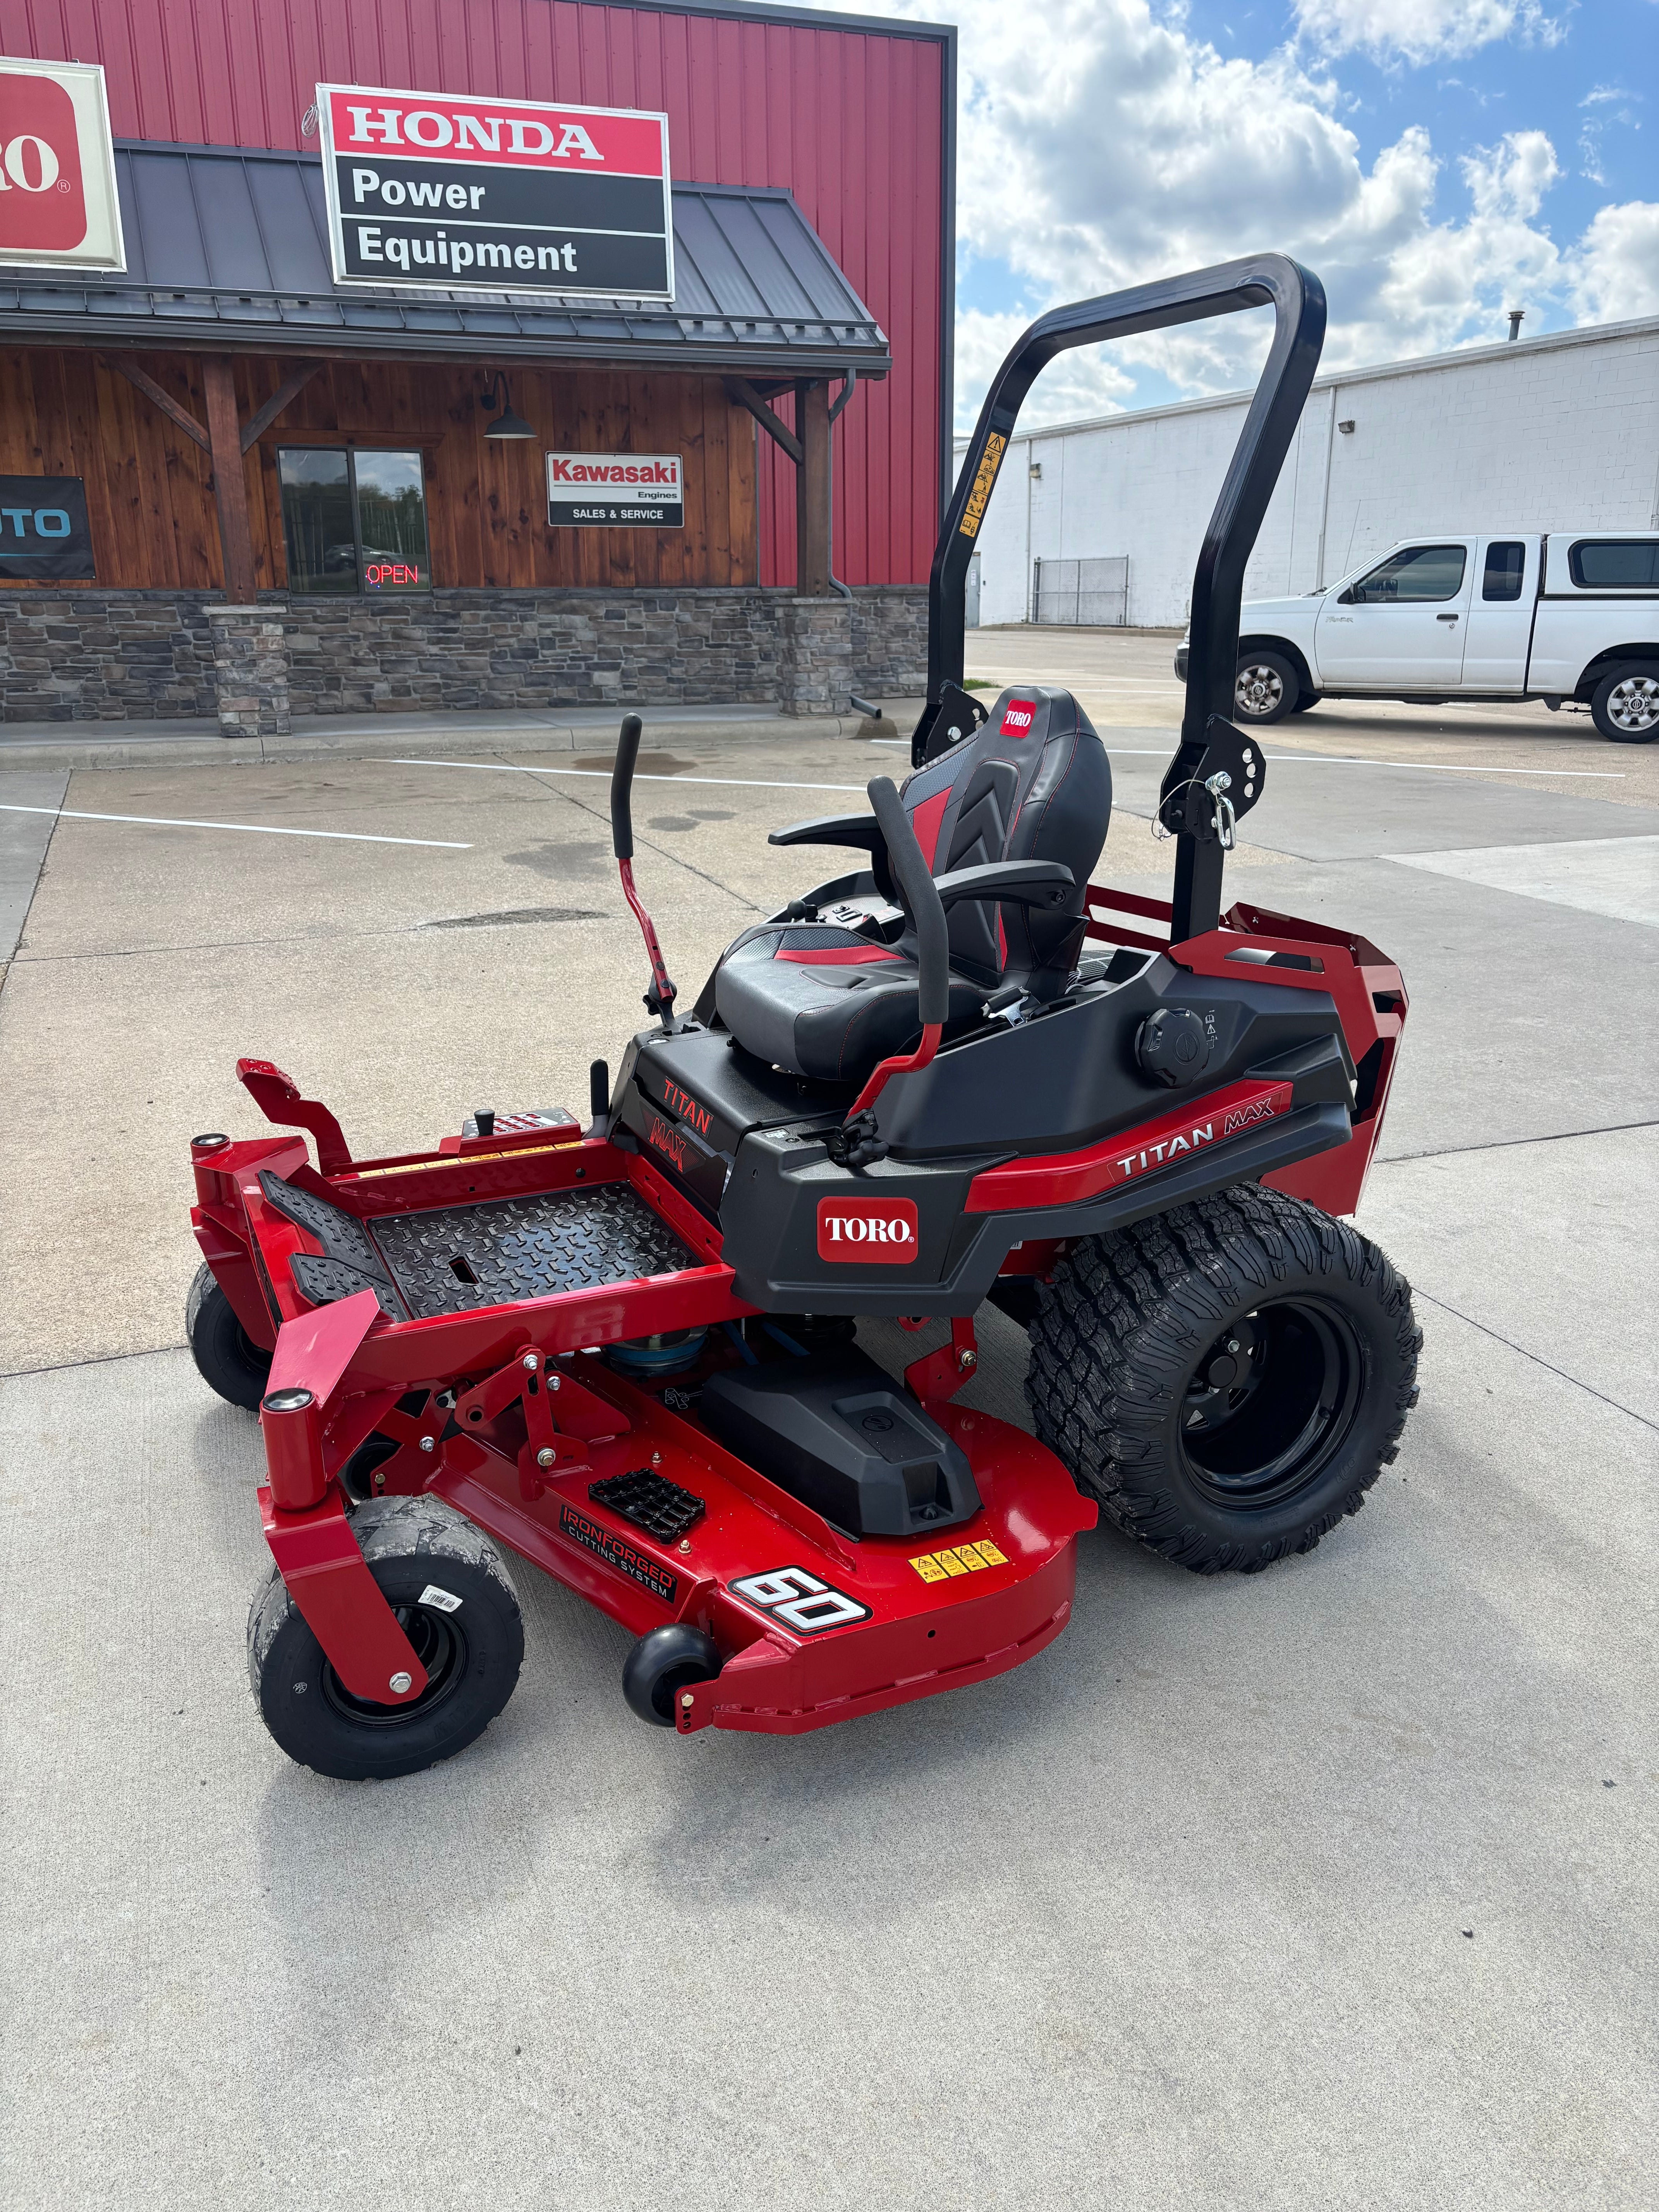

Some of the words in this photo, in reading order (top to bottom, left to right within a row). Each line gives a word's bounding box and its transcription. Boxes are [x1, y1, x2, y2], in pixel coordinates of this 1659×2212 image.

[346, 106, 605, 160] HONDA
[352, 168, 486, 210] Power
[357, 227, 577, 273] Equipment
[553, 459, 677, 483] Kawasaki
[573, 508, 606, 519] SALES
[610, 510, 617, 519] &
[620, 510, 663, 519] SERVICE
[638, 491, 677, 500] Engines
[0, 508, 71, 537] TO
[366, 565, 418, 584] OPEN
[1005, 710, 1031, 727] TORO
[649, 1117, 687, 1173] MAX
[1116, 1123, 1213, 1177] TITAN
[1224, 1097, 1275, 1135] MAX
[569, 1527, 616, 1563] CUTTING
[620, 1561, 667, 1598] SYSTEM
[732, 1568, 866, 1633] 60
